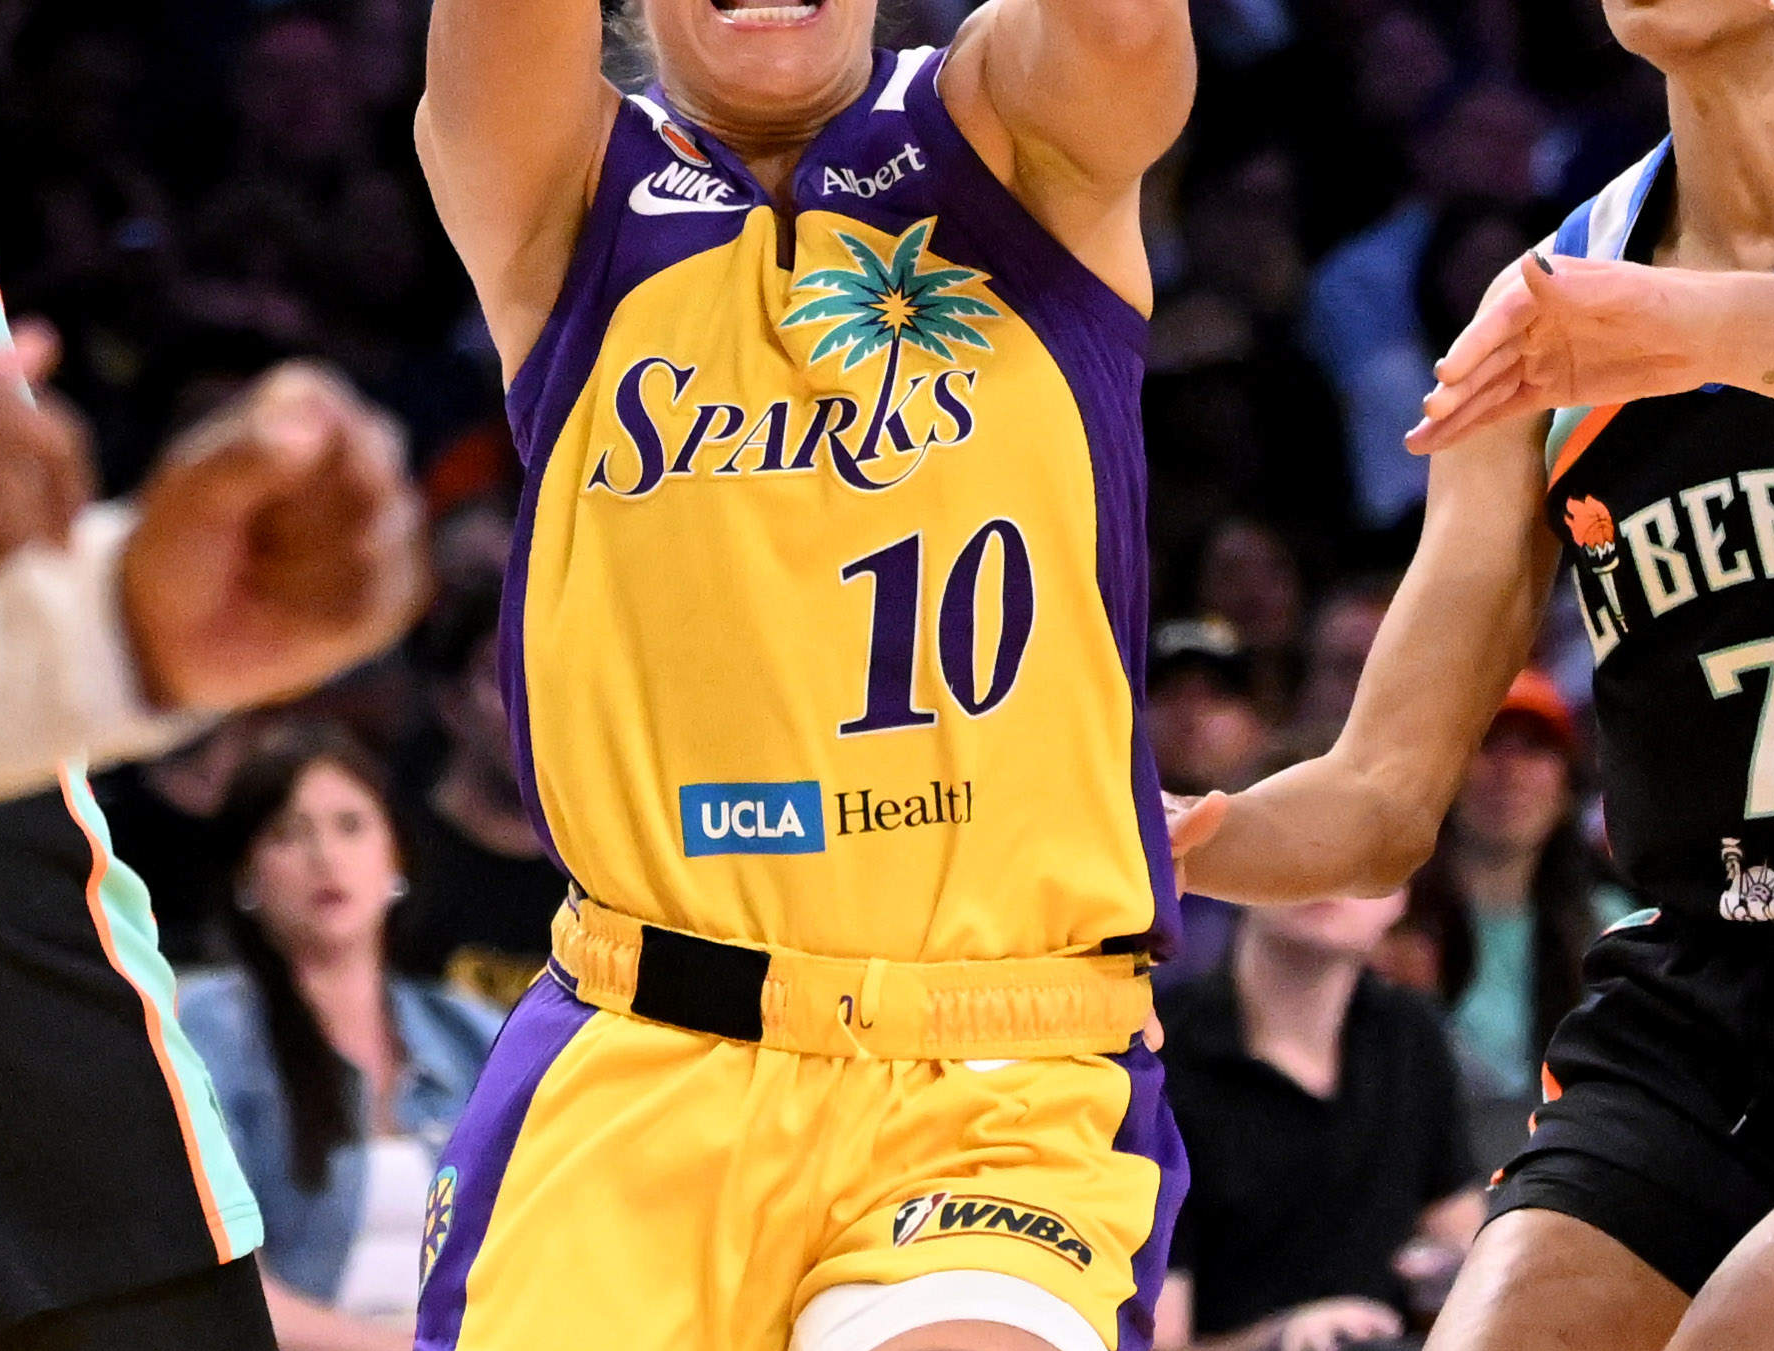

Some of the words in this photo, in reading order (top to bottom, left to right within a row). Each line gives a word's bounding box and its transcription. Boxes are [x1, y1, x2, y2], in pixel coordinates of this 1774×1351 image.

[653, 160, 735, 204] NIKE
[821, 142, 927, 199] Albert
[836, 516, 1036, 739] 10
[700, 799, 806, 840] UCLA
[939, 1201, 1093, 1266] WNBA
